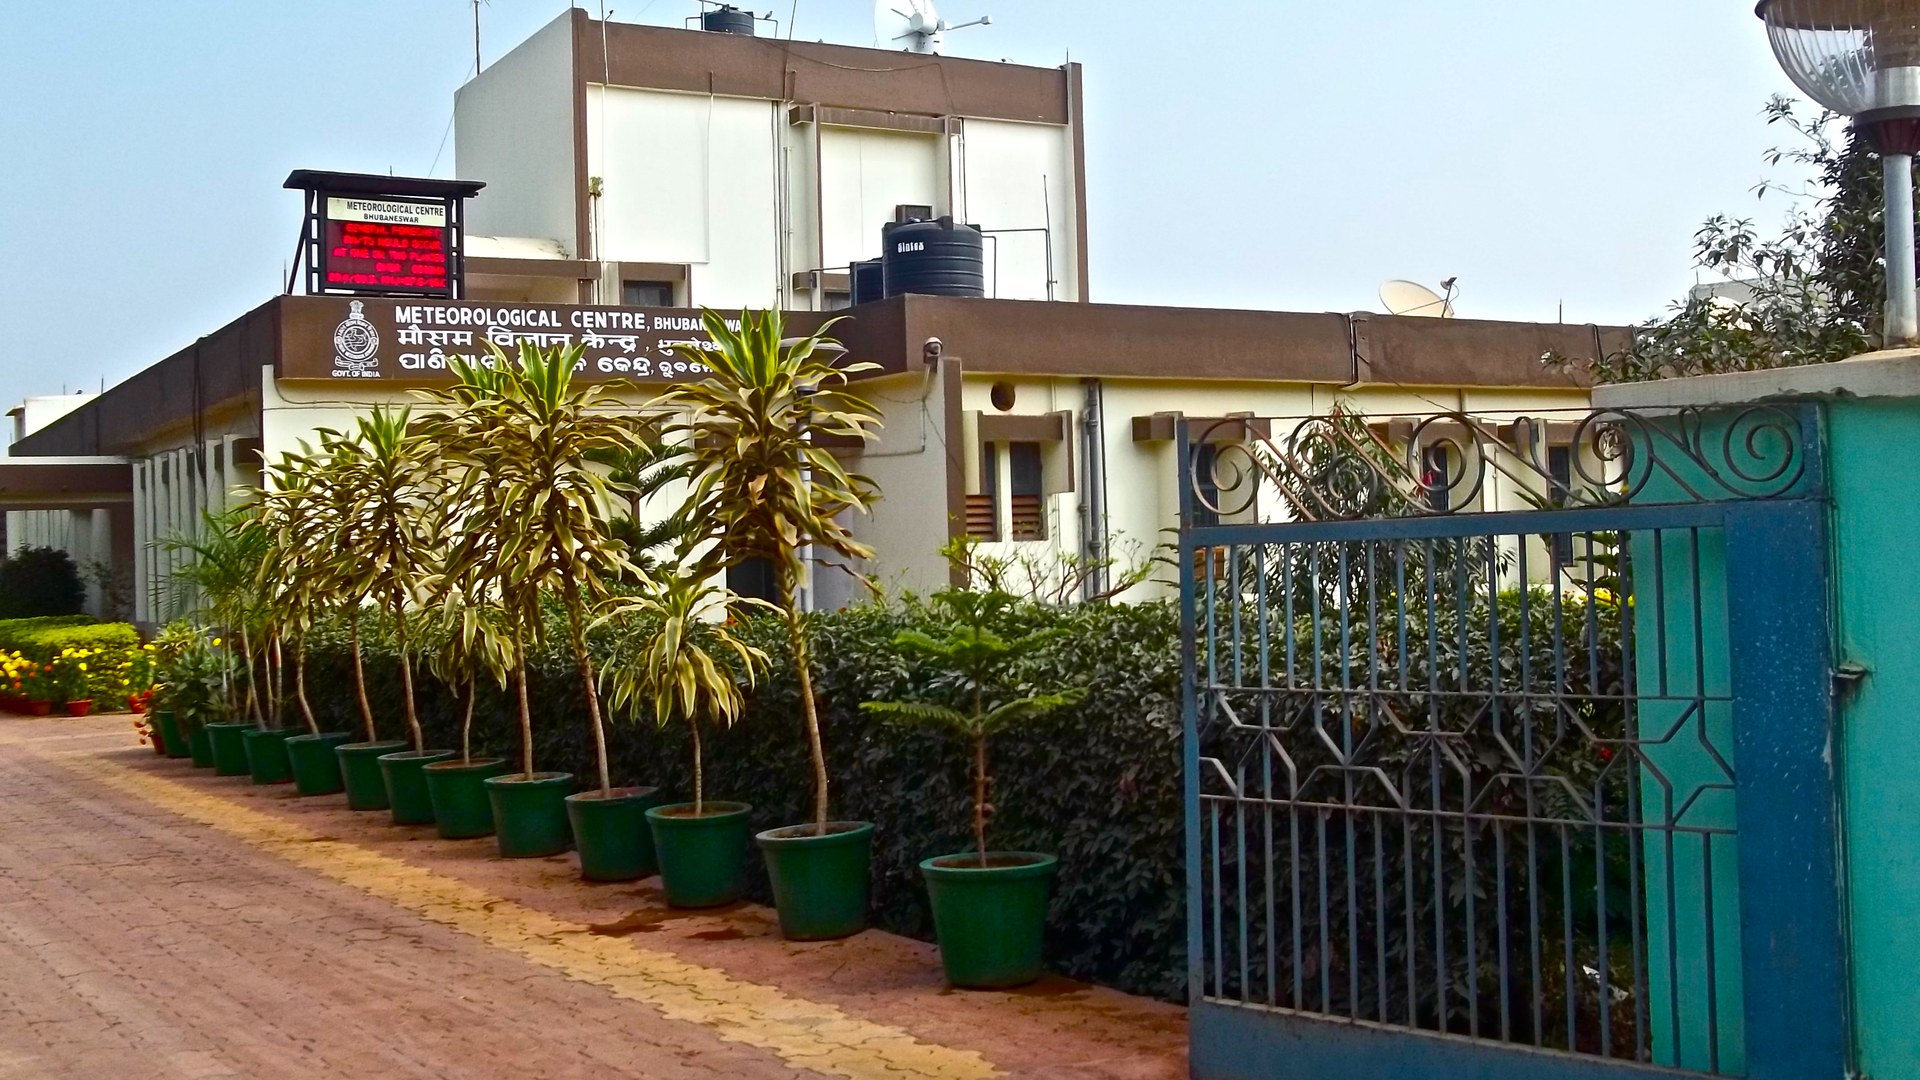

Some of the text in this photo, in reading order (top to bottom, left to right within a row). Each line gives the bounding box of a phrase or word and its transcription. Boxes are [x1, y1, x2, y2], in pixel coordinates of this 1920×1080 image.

[347, 201, 444, 216] METEOROLOGICAL CENTRE
[364, 213, 419, 223] BHUBANESWAR
[395, 305, 742, 333] METEOROLOGICAL CENTRE, BHUBANWA
[396, 323, 474, 347] मौसम
[351, 370, 361, 378] OF
[361, 370, 381, 378] INDIA
